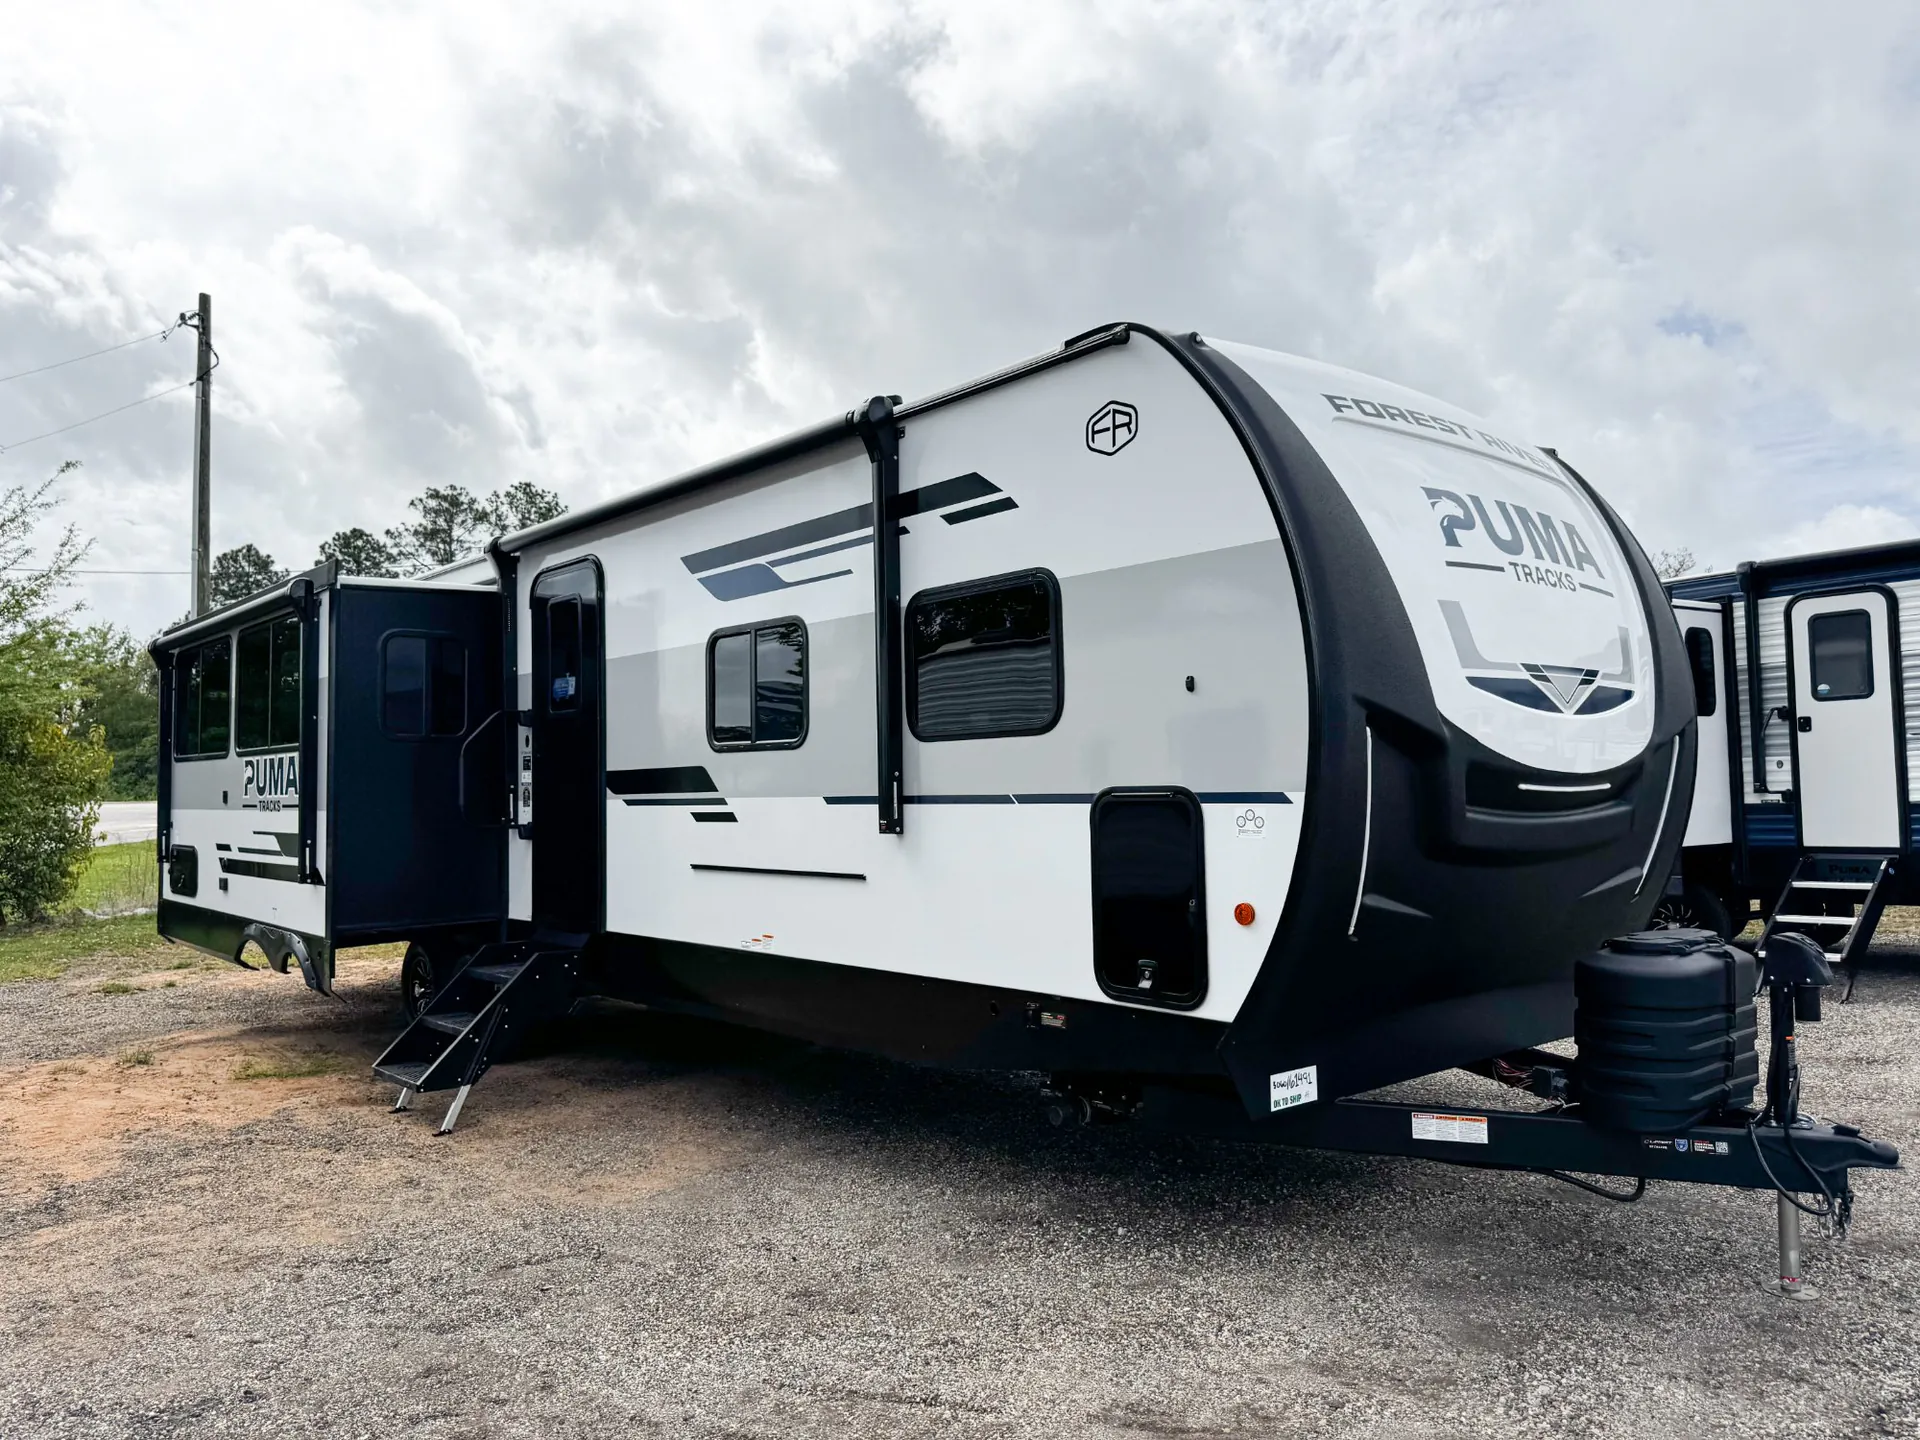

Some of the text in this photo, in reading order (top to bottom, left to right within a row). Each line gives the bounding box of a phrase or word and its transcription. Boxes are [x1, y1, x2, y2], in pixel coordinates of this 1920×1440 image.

[1321, 393, 1474, 440] FOREST
[1420, 486, 1606, 580] PUMA
[1508, 561, 1577, 593] TRACKS
[243, 755, 299, 798] PUMA
[258, 800, 282, 812] TRACKS
[1282, 1096, 1289, 1106] TO
[1289, 1093, 1302, 1105] SHIP
